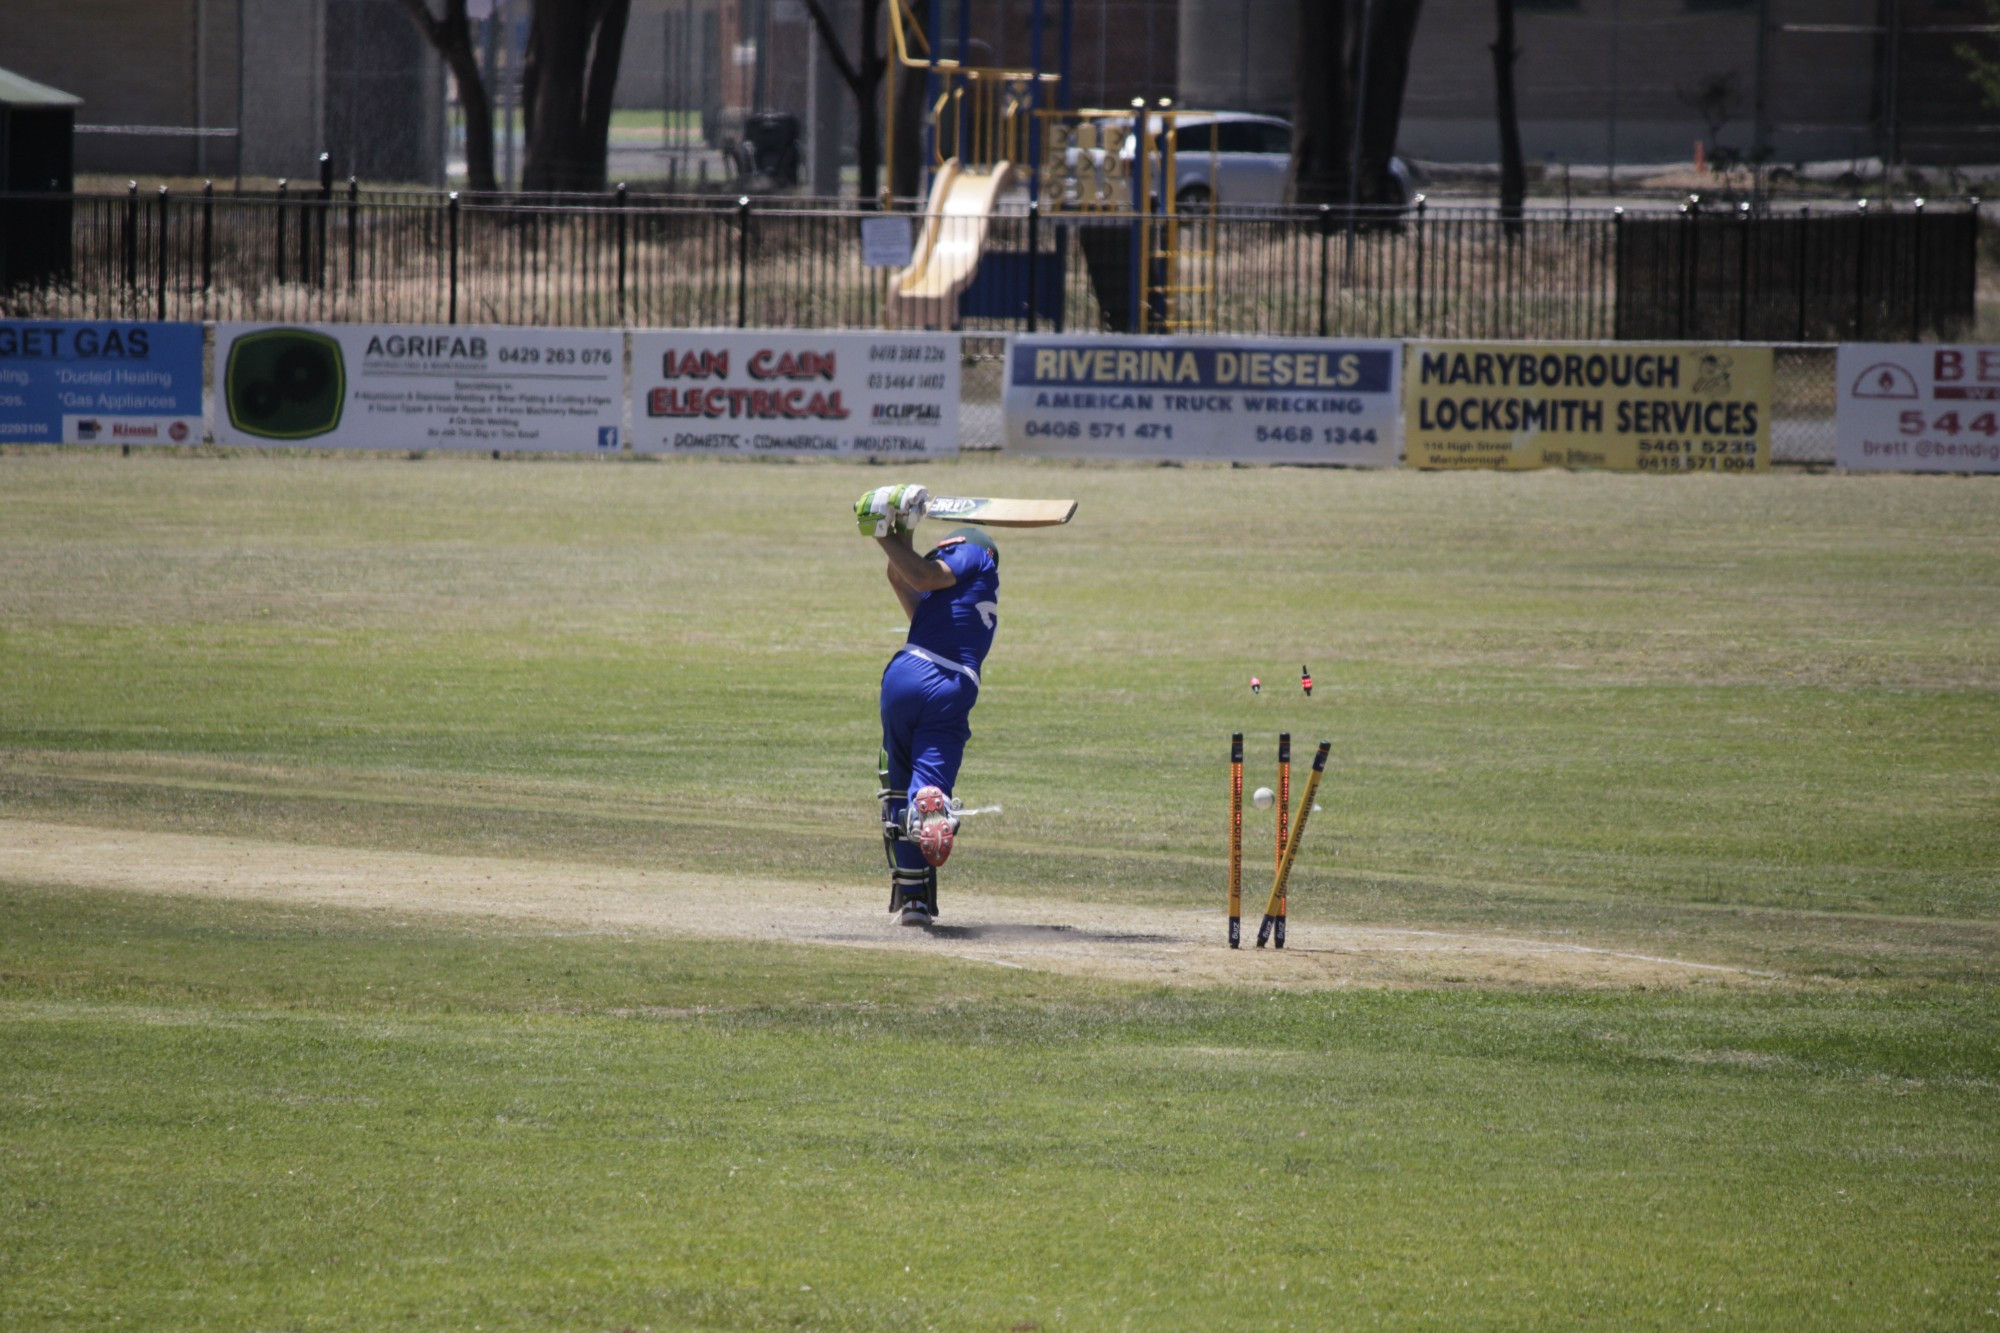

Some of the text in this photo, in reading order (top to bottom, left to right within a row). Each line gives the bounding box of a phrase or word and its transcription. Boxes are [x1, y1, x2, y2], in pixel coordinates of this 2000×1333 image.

[74, 327, 149, 358] GAS
[365, 335, 612, 365] AGRIFAB 0429 263 076
[663, 348, 835, 381] IAN CAIN
[1035, 349, 1360, 386] RIVERINA DIESELS
[1420, 352, 1680, 388] MARYBOROUGH
[1934, 350, 2000, 381] BE
[117, 369, 172, 388] Heating
[97, 393, 177, 410] Appliances
[648, 387, 850, 419] ELECTRICAL
[885, 403, 941, 418] CLIPSAL
[1036, 393, 1363, 415] AMERICAN TRUCK WRECKING
[1419, 398, 1758, 436] LOCKSMITH SERVICES
[1900, 411, 1999, 436] 544
[674, 433, 740, 449] DOMESTIC
[753, 434, 839, 450] COMMERCIAL
[853, 435, 927, 451] INDUSTRIAL
[1025, 422, 1377, 444] 0408 571 471 5468 1344
[1231, 921, 1240, 939] Zing
[1262, 920, 1273, 938] Zing
[1277, 920, 1286, 938] Zing
